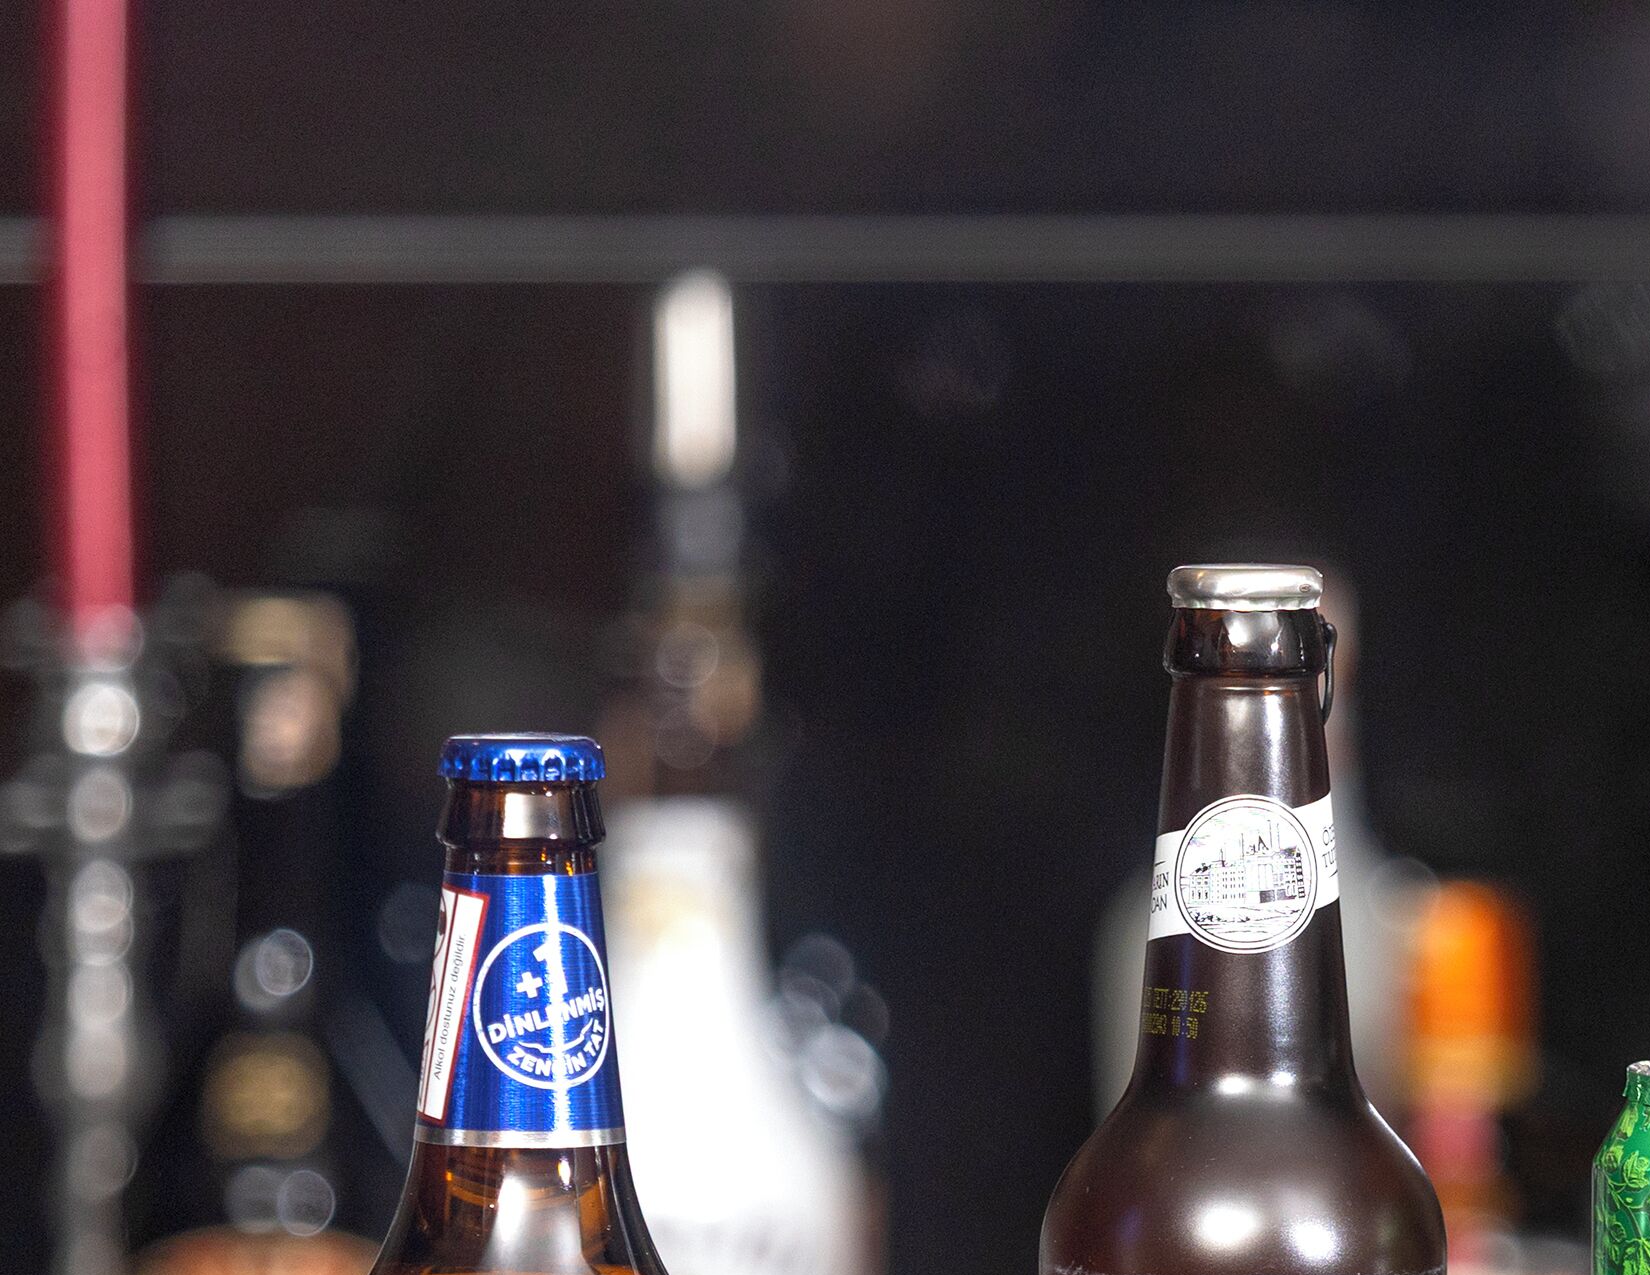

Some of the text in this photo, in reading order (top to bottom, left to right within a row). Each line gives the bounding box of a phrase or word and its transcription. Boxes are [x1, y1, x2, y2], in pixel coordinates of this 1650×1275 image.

[434, 934, 467, 1080] Alkol dostunuz değildir.
[487, 987, 605, 1044] DİNLNMİŞ
[506, 1019, 604, 1077] ZENİN TAT
